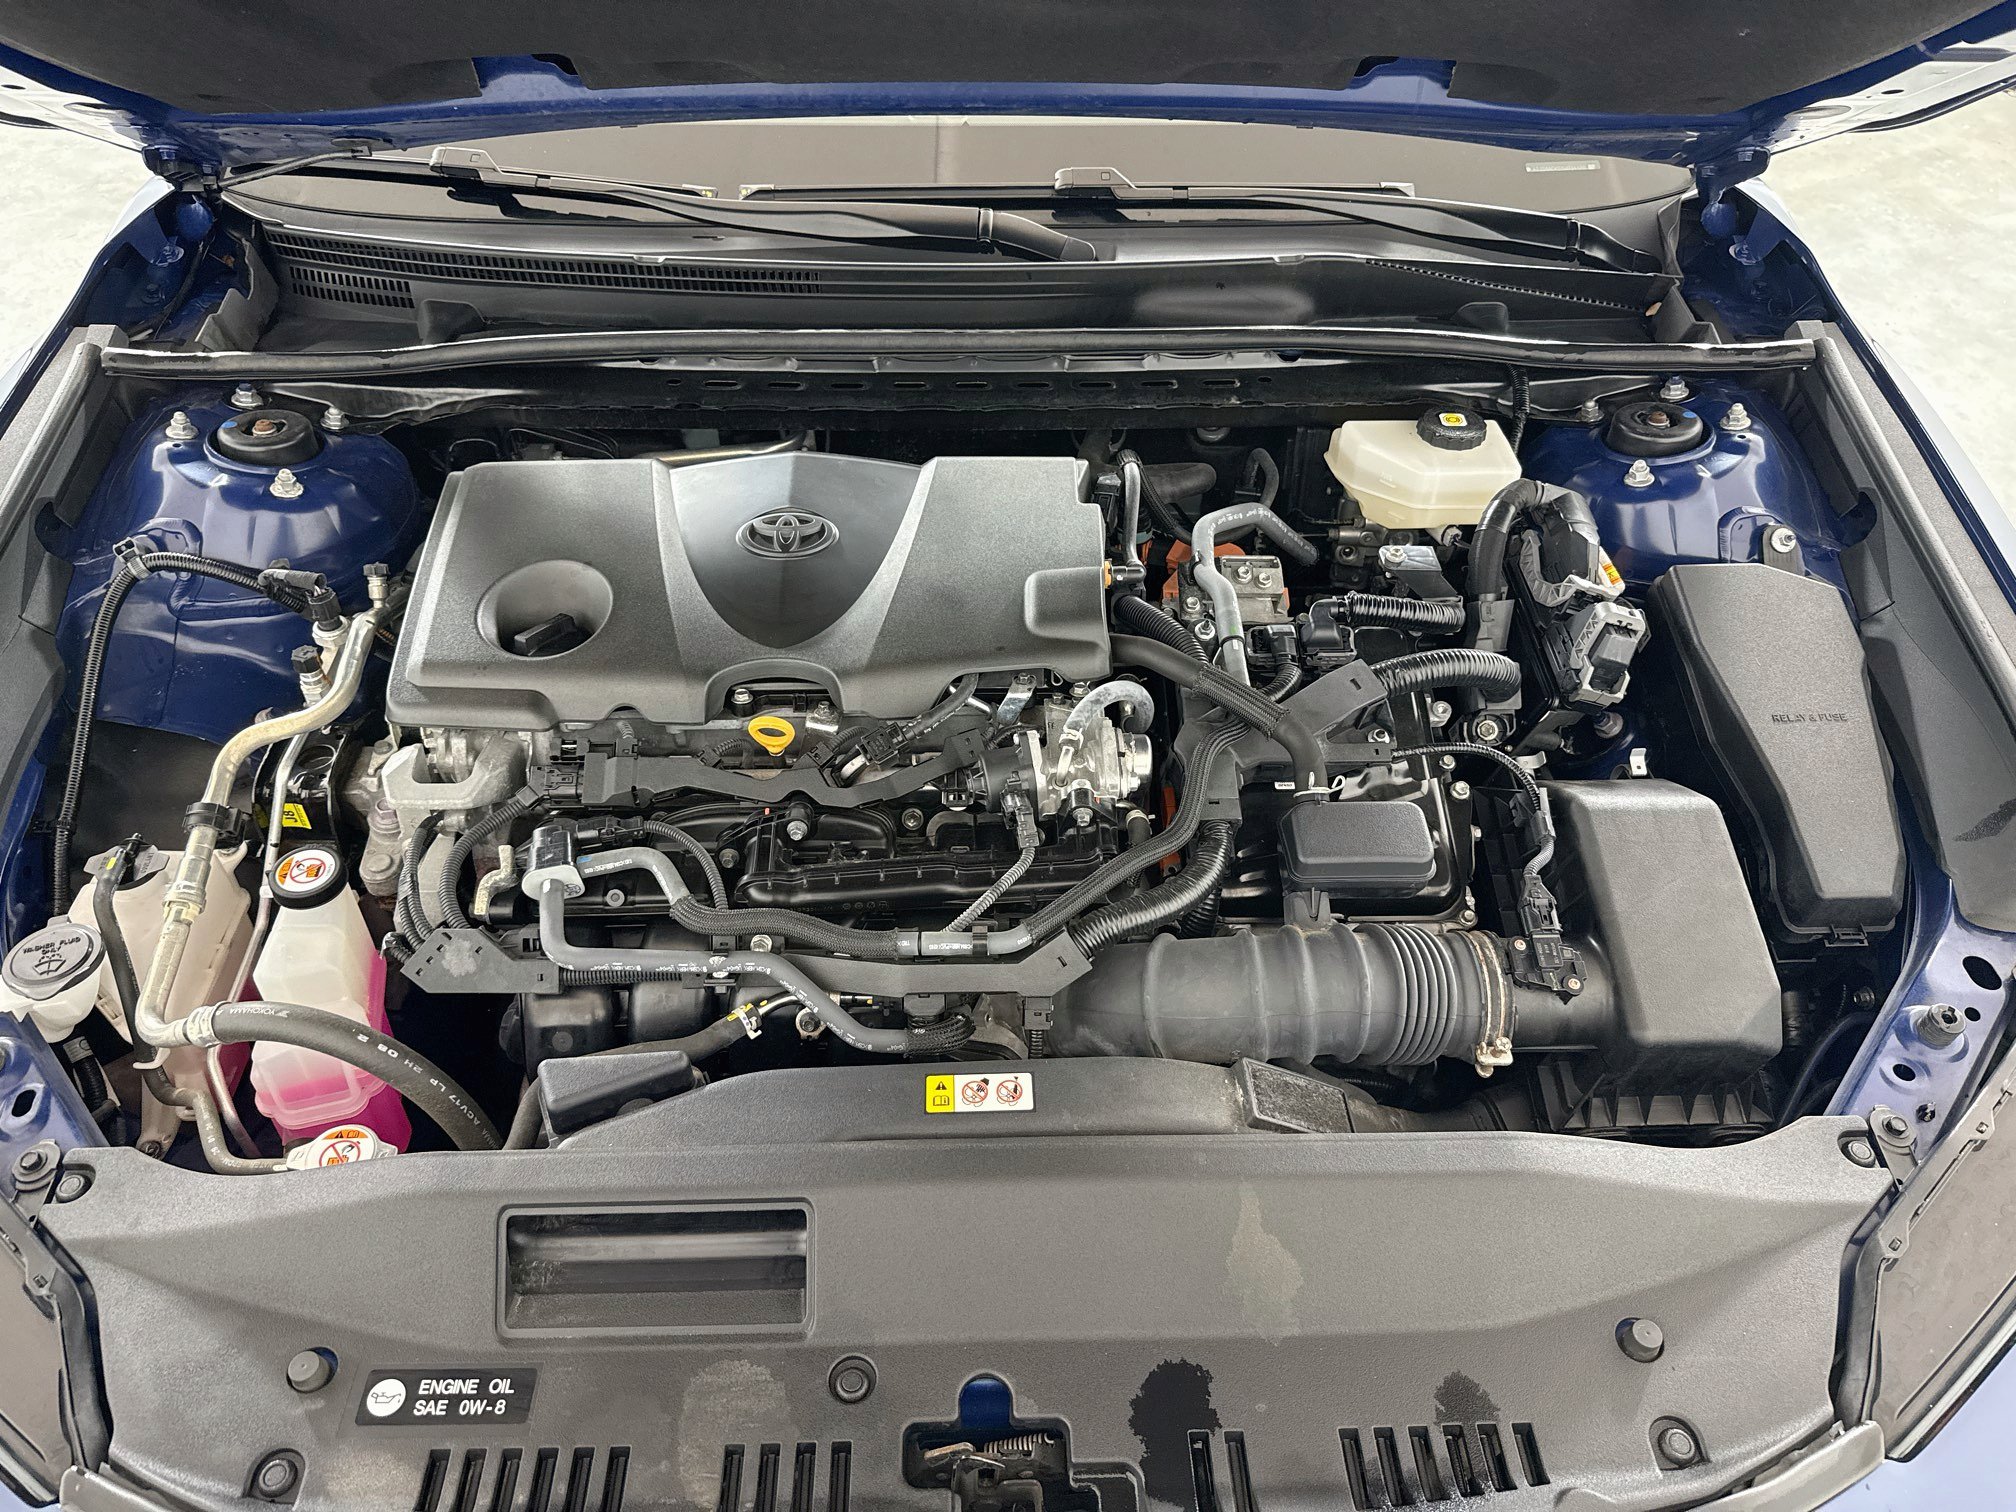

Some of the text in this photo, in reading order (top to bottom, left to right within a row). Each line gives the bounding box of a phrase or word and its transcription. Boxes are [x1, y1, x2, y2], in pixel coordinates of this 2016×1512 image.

[1771, 713, 1848, 723] RELAY & FUSE
[23, 936, 81, 954] WASHER FLUID
[229, 1008, 275, 1016] YOKOHAMA
[403, 1058, 423, 1074] 2H
[429, 1078, 447, 1092] LP
[448, 1094, 481, 1126] ACV17
[418, 1378, 515, 1395] ENGINE OIL
[413, 1399, 506, 1416] SAE 0W-8
